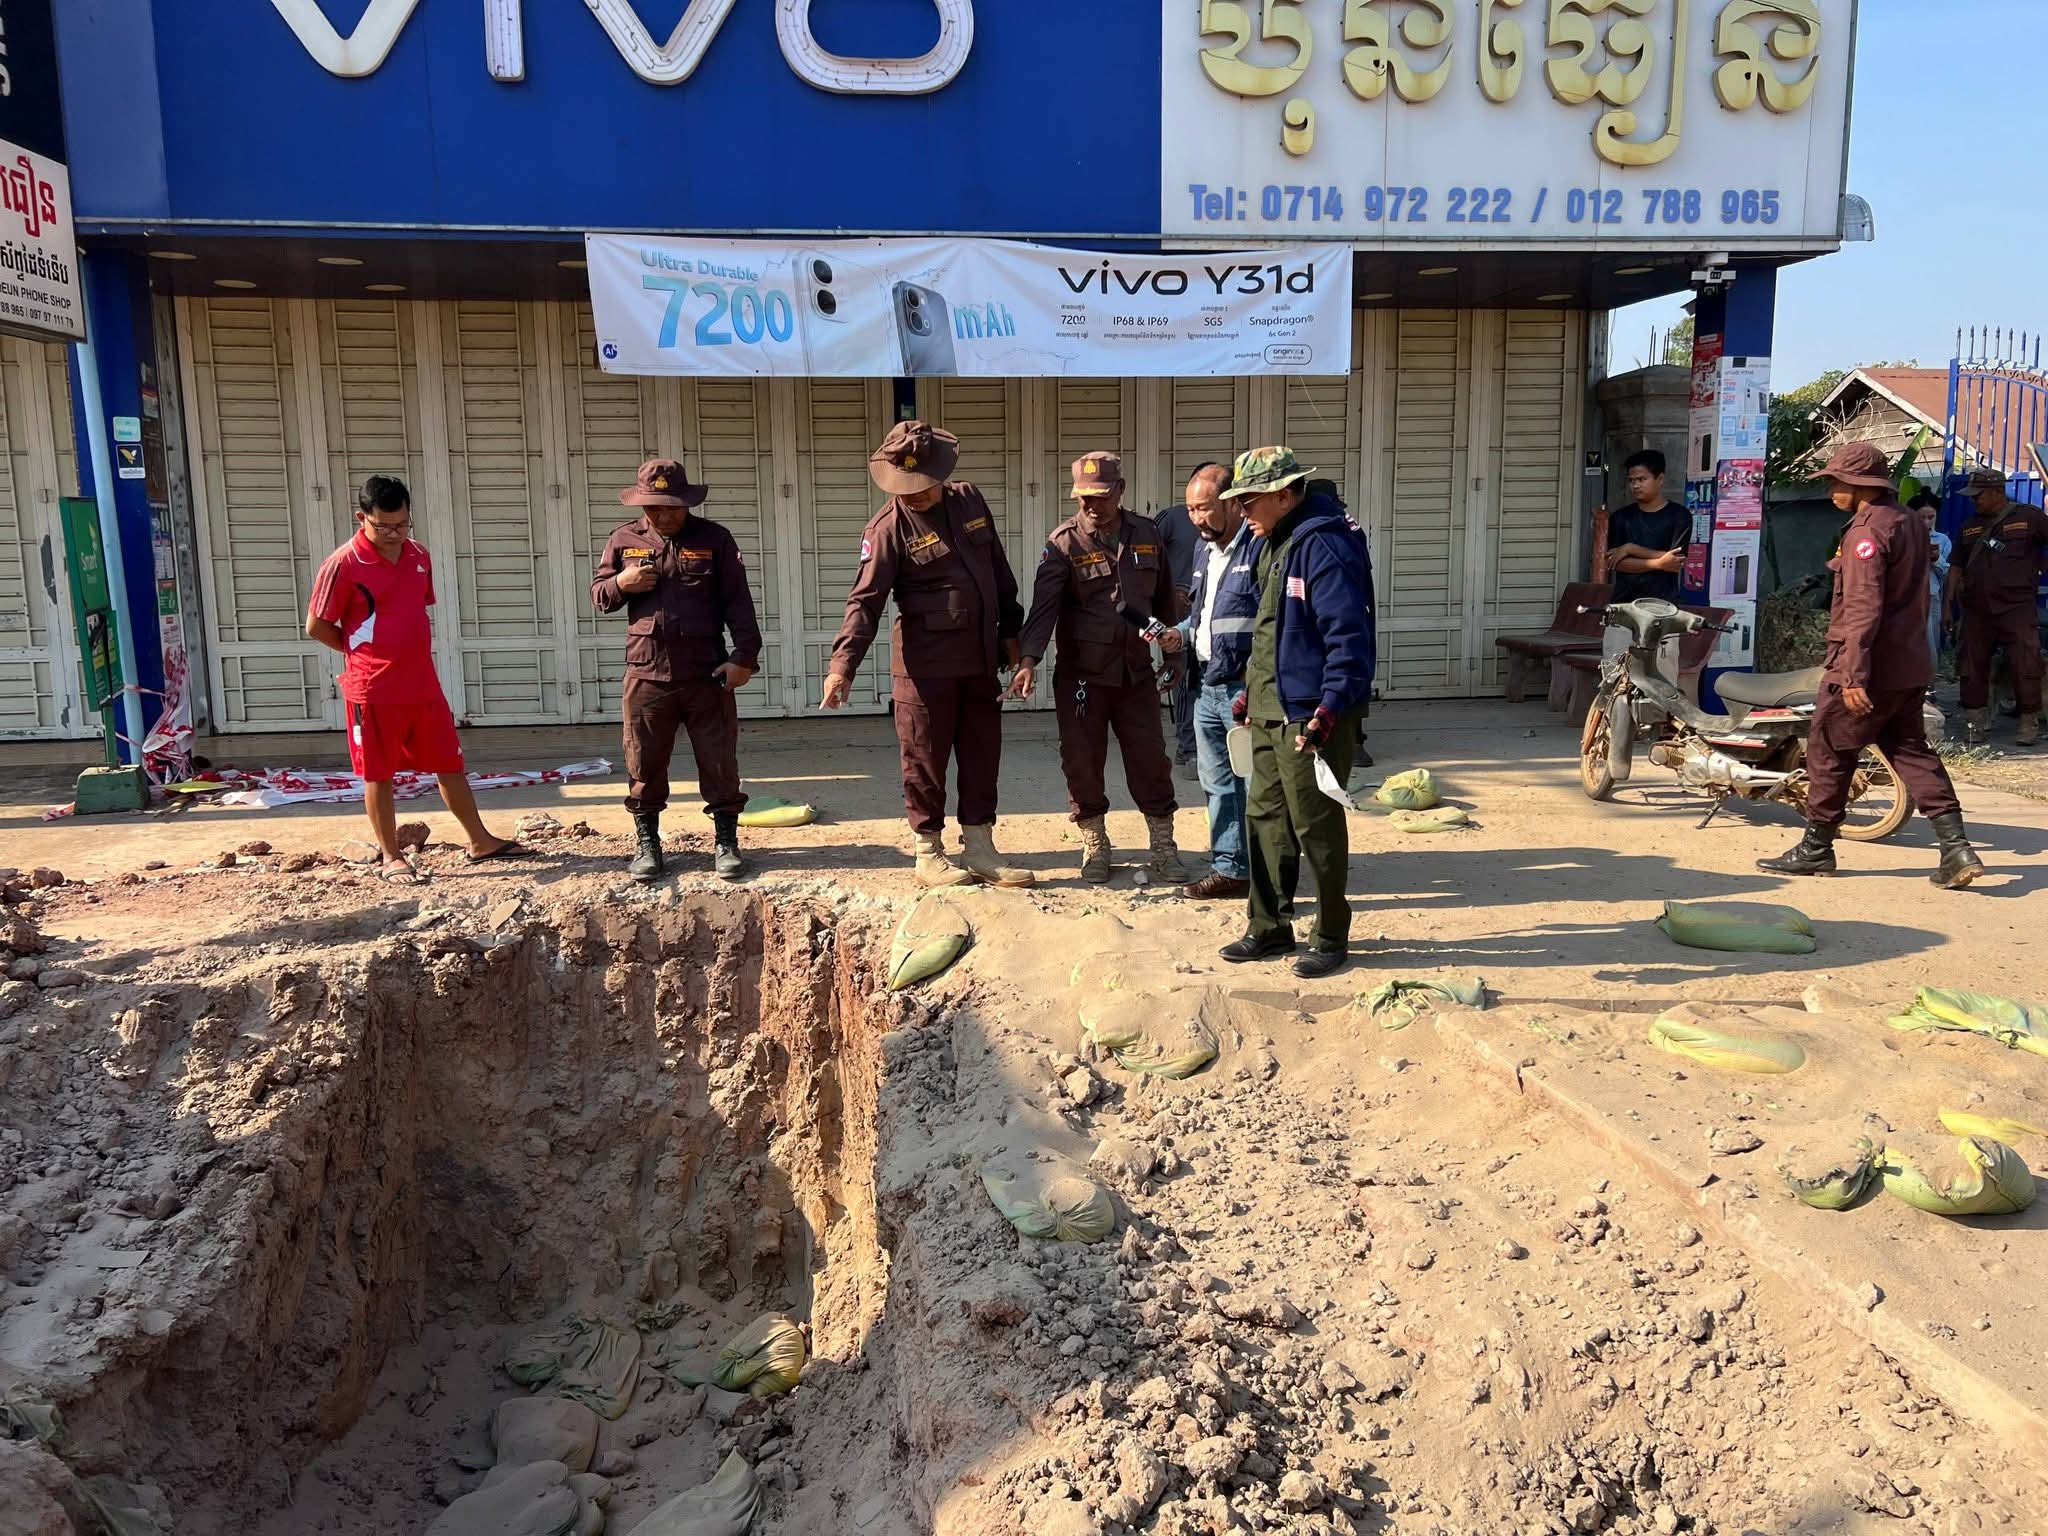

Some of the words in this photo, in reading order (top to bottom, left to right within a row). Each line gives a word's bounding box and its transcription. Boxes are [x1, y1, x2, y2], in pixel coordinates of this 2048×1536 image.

[1189, 184, 1247, 221] Tel:
[1261, 185, 1344, 222] 0714
[1364, 187, 1428, 222] 972
[1446, 187, 1512, 223] 222
[1530, 188, 1548, 223] /
[1566, 188, 1623, 224] 012
[1642, 189, 1701, 224] 788
[1721, 189, 1779, 224] 965
[641, 248, 693, 273] Ultra
[698, 259, 759, 281] Durable
[1057, 259, 1188, 296] vivo
[1203, 263, 1314, 295] Y31d
[0, 281, 19, 297] EUN
[21, 287, 49, 304] PHONE
[50, 295, 71, 310] SHOP
[642, 274, 794, 348] 7200
[11, 304, 24, 317] 965
[30, 308, 41, 320] 097
[54, 314, 63, 325] 111
[953, 302, 1016, 339] mAh
[1113, 316, 1134, 326] IP68
[1137, 317, 1145, 326] &
[1147, 317, 1169, 326] IP69
[1204, 317, 1223, 327] SGS
